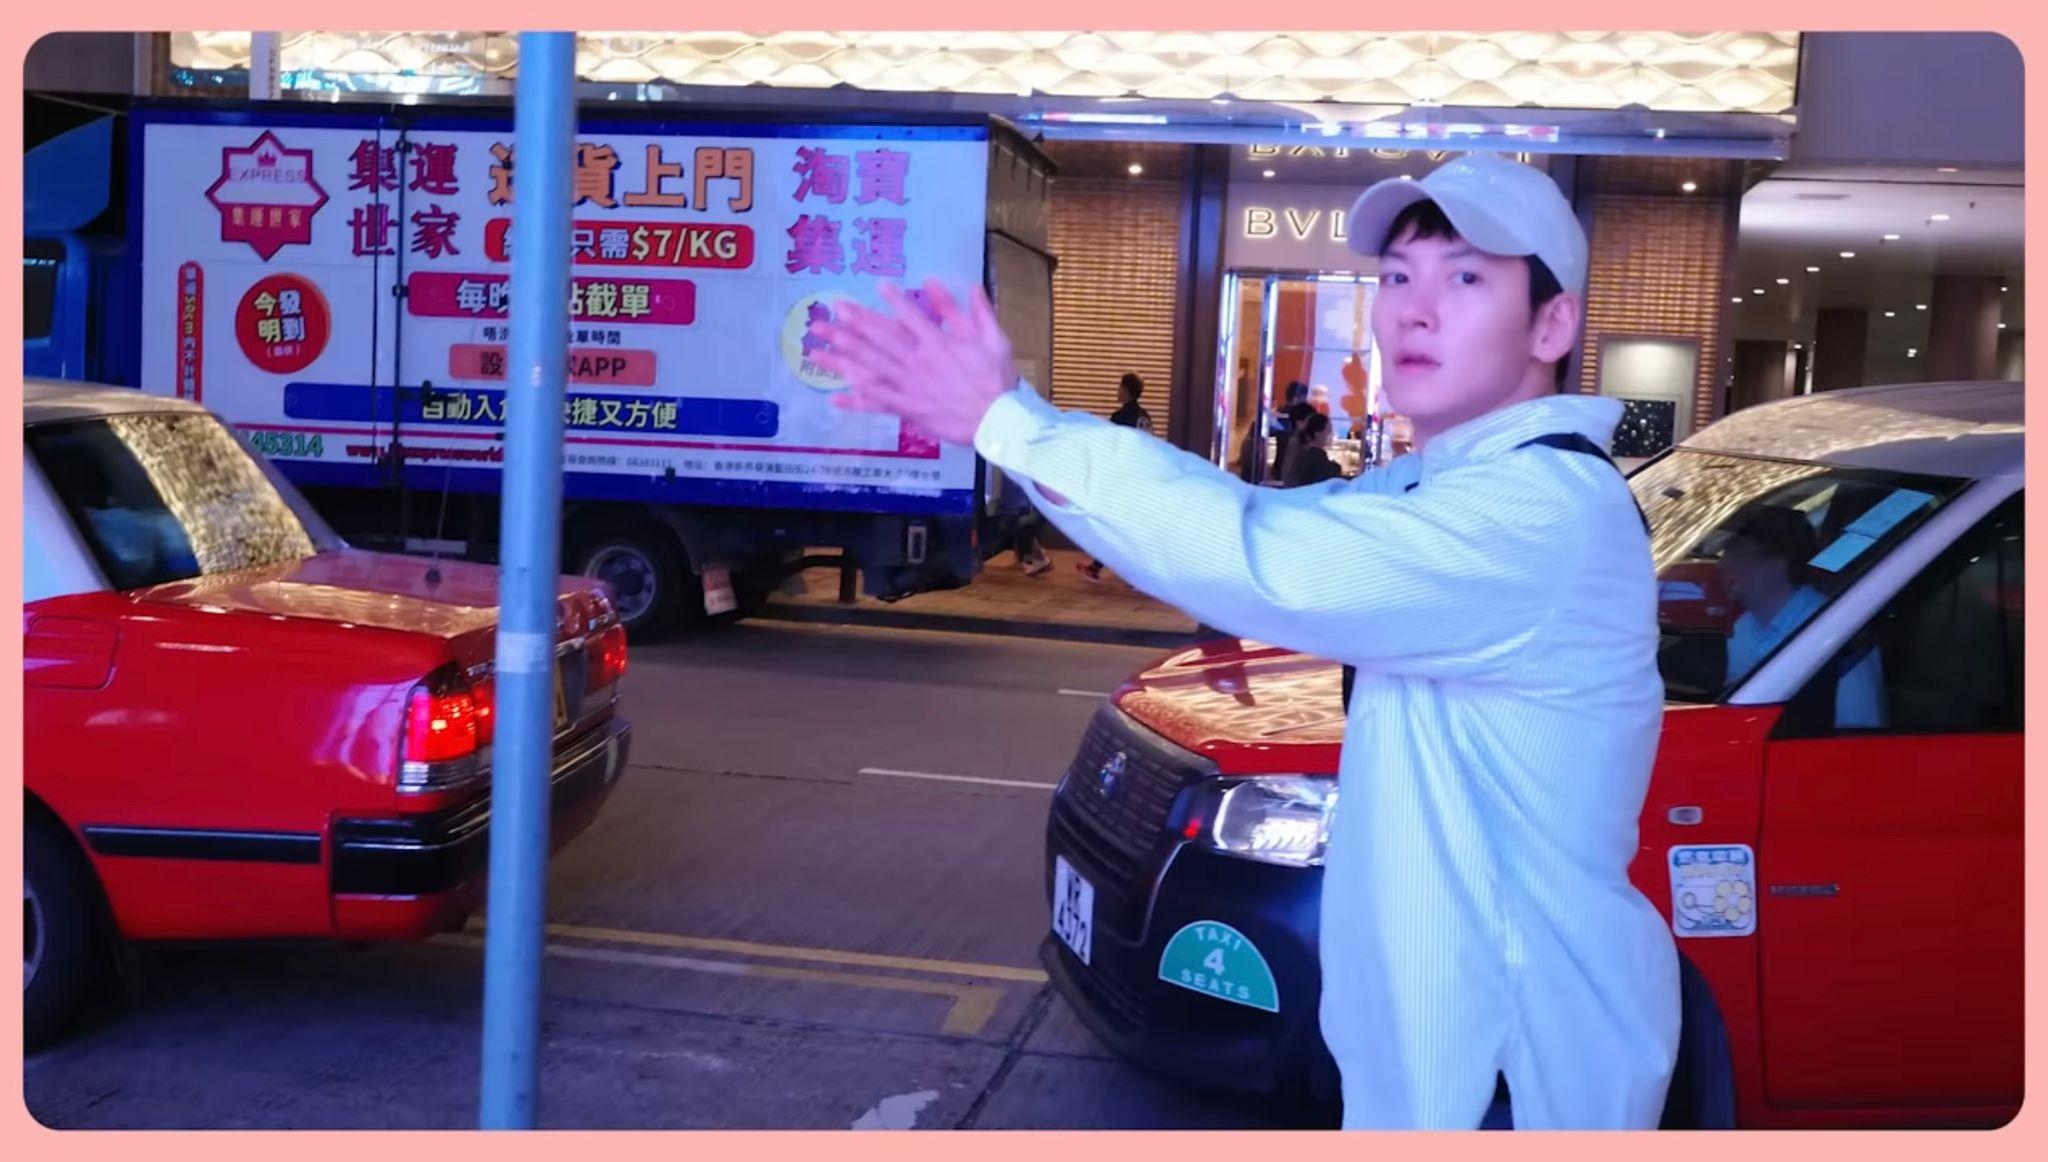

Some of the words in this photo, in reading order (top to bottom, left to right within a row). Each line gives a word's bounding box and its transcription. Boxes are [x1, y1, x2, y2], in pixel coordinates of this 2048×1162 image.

[229, 168, 306, 184] EXPRESS
[785, 214, 908, 278] 集運
[1194, 926, 1243, 951] TAXI
[1203, 948, 1226, 975] 4
[1181, 968, 1251, 1001] SEATS
